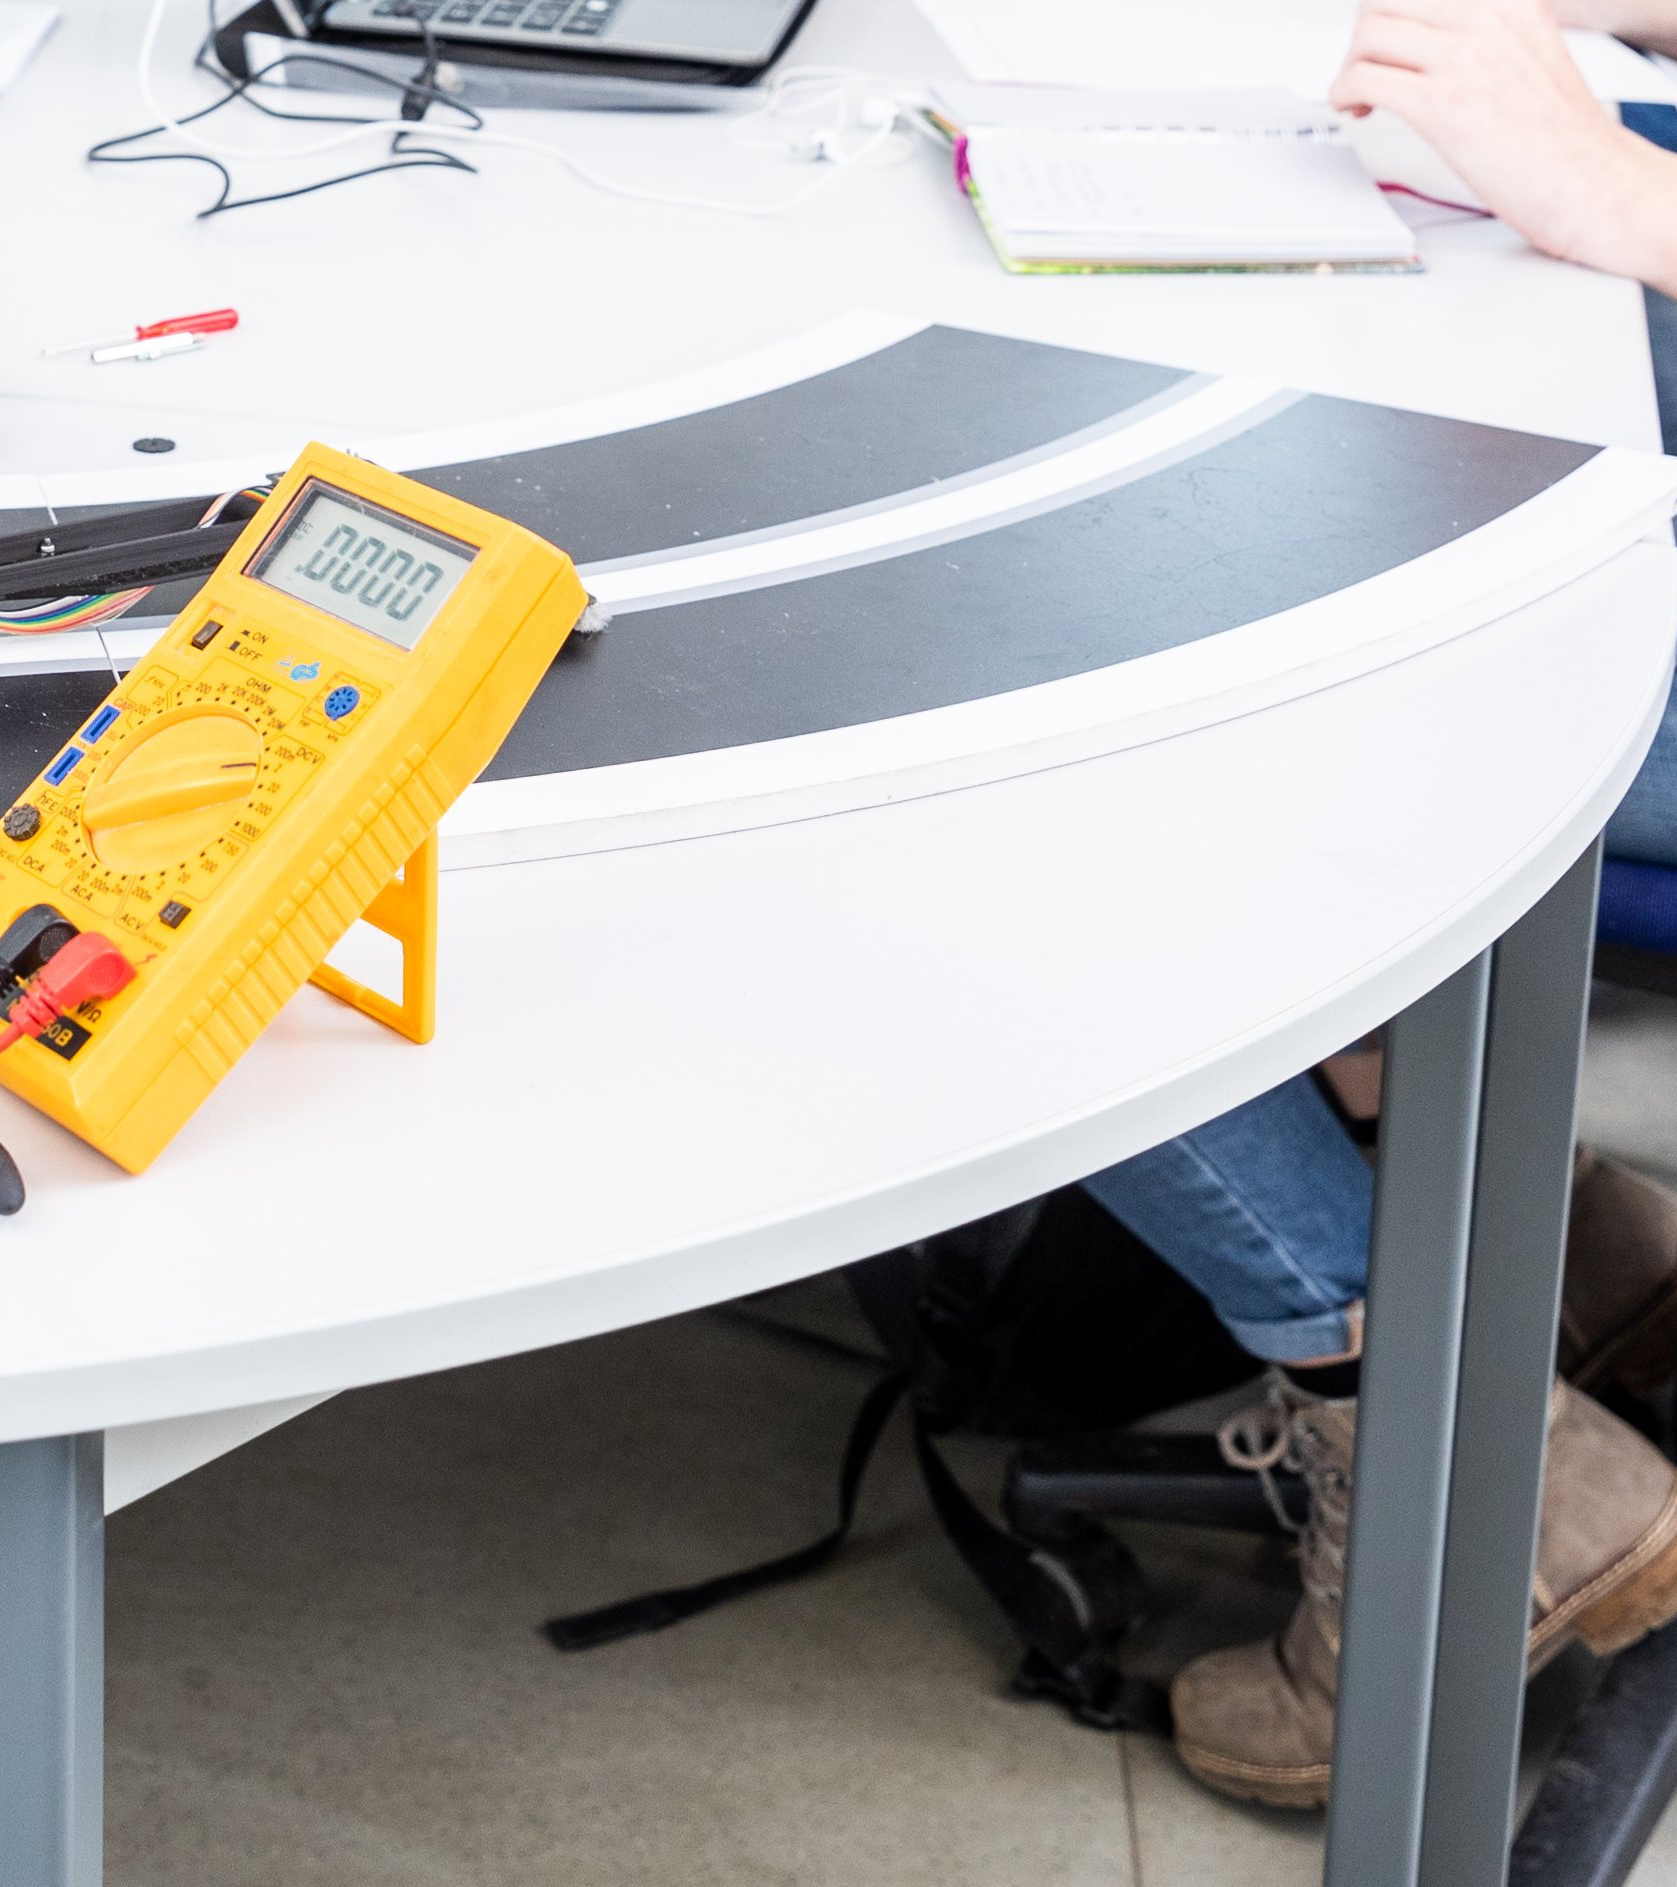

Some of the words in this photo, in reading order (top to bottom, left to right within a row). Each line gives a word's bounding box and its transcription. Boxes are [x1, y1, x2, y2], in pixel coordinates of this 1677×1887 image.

[252, 631, 269, 645] ON
[239, 646, 263, 662] OFF
[195, 682, 212, 695] 200
[231, 685, 248, 699] 20K
[246, 677, 272, 694] OHM
[152, 696, 166, 707] 20
[246, 692, 266, 708] 200K
[134, 704, 151, 717] 200
[267, 717, 286, 731] 20M
[38, 793, 59, 813] hFE
[23, 855, 45, 873] DCA
[70, 884, 94, 902] ACA
